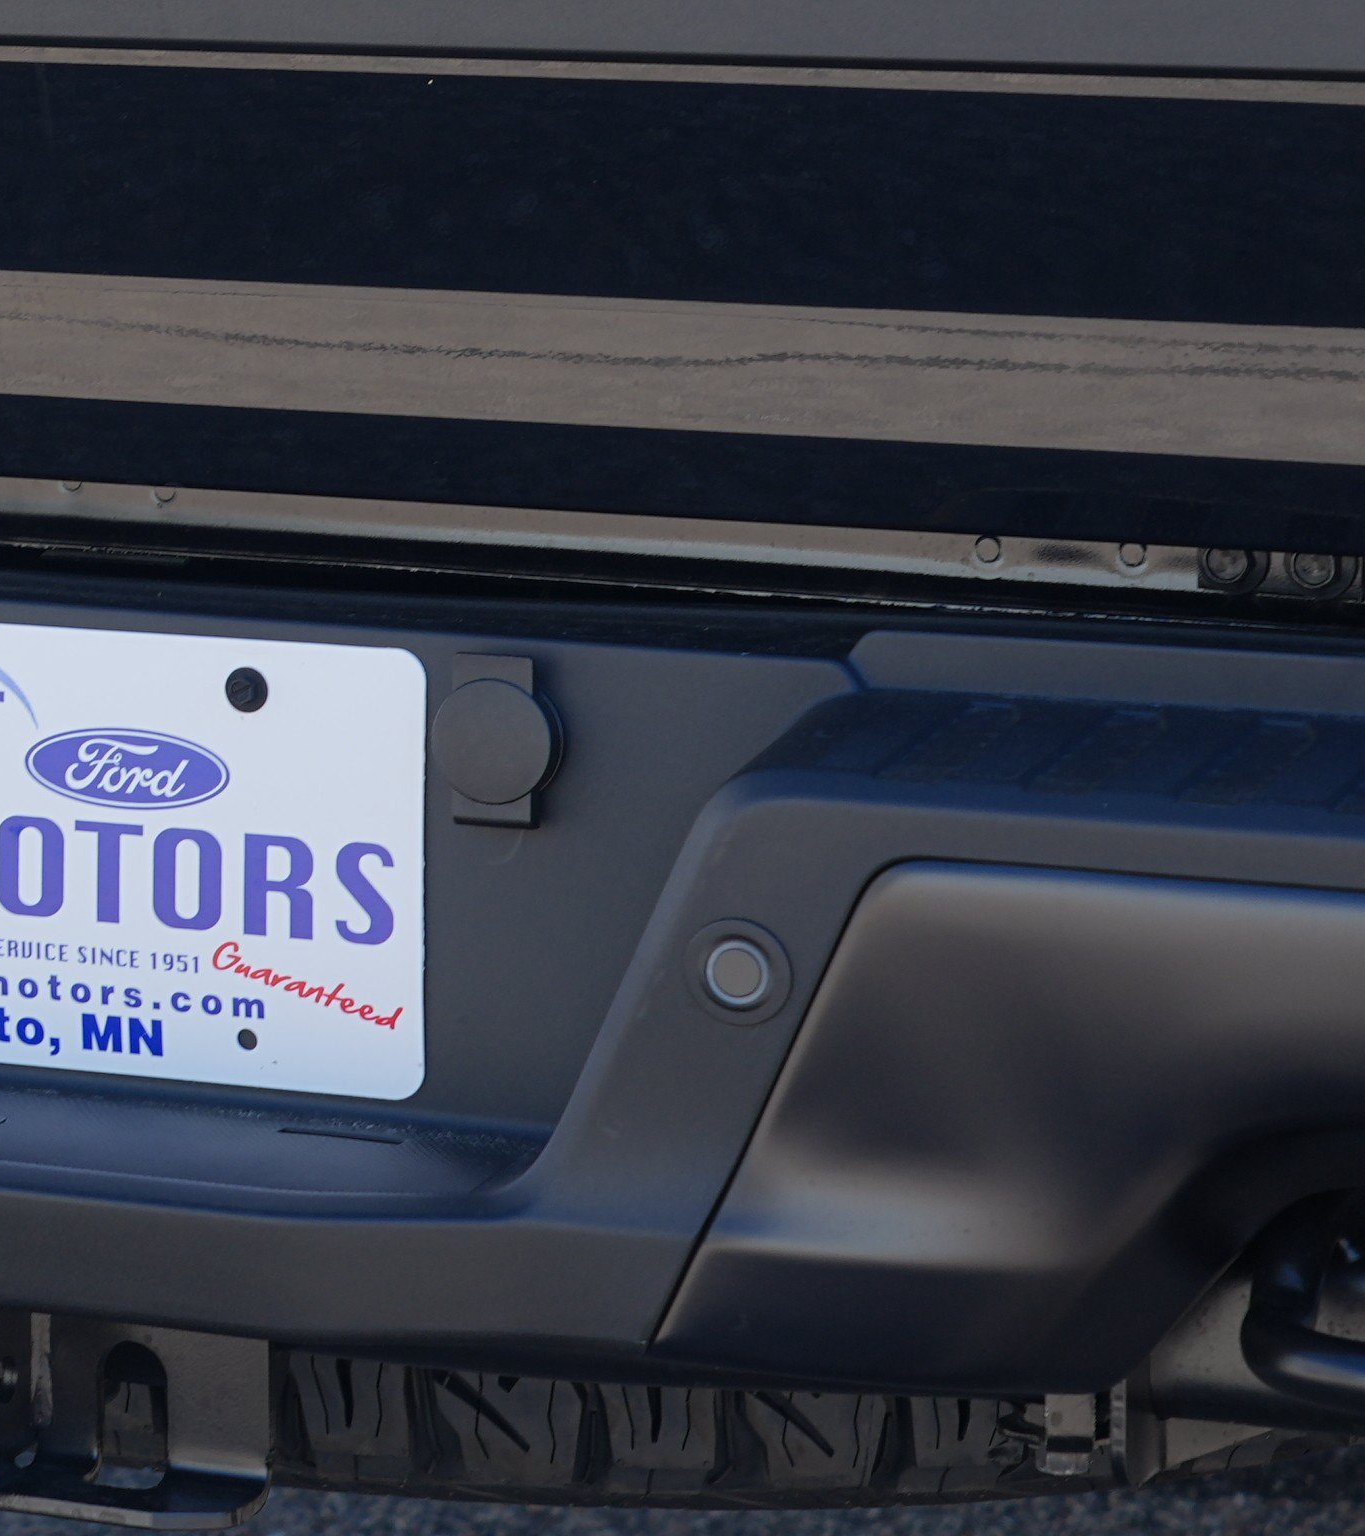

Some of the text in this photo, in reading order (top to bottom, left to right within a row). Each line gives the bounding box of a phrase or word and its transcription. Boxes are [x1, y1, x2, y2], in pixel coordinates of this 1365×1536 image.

[65, 737, 190, 799] Ford
[78, 945, 140, 969] SINCE
[150, 952, 200, 974] 1951
[212, 941, 404, 1030] Guaranteed
[82, 1012, 164, 1057] MN
